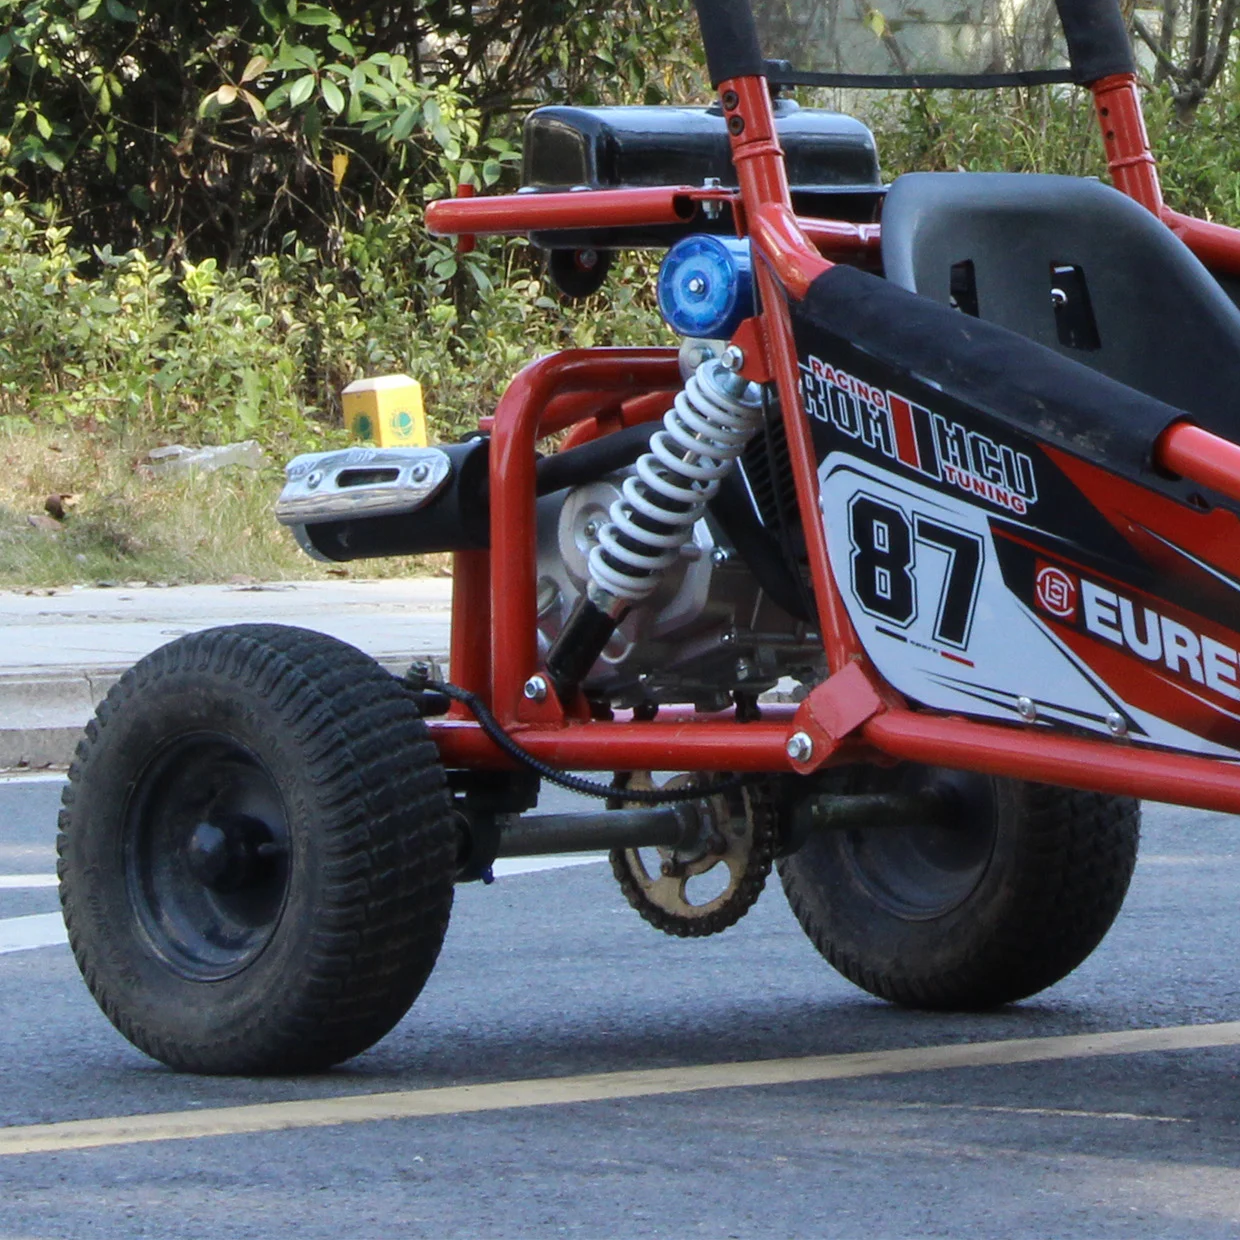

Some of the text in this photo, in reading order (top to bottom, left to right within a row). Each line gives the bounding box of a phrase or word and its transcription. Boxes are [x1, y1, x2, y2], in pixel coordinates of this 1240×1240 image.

[808, 355, 887, 408] RACING
[942, 462, 1027, 515] TUNING
[847, 489, 986, 652] 87
